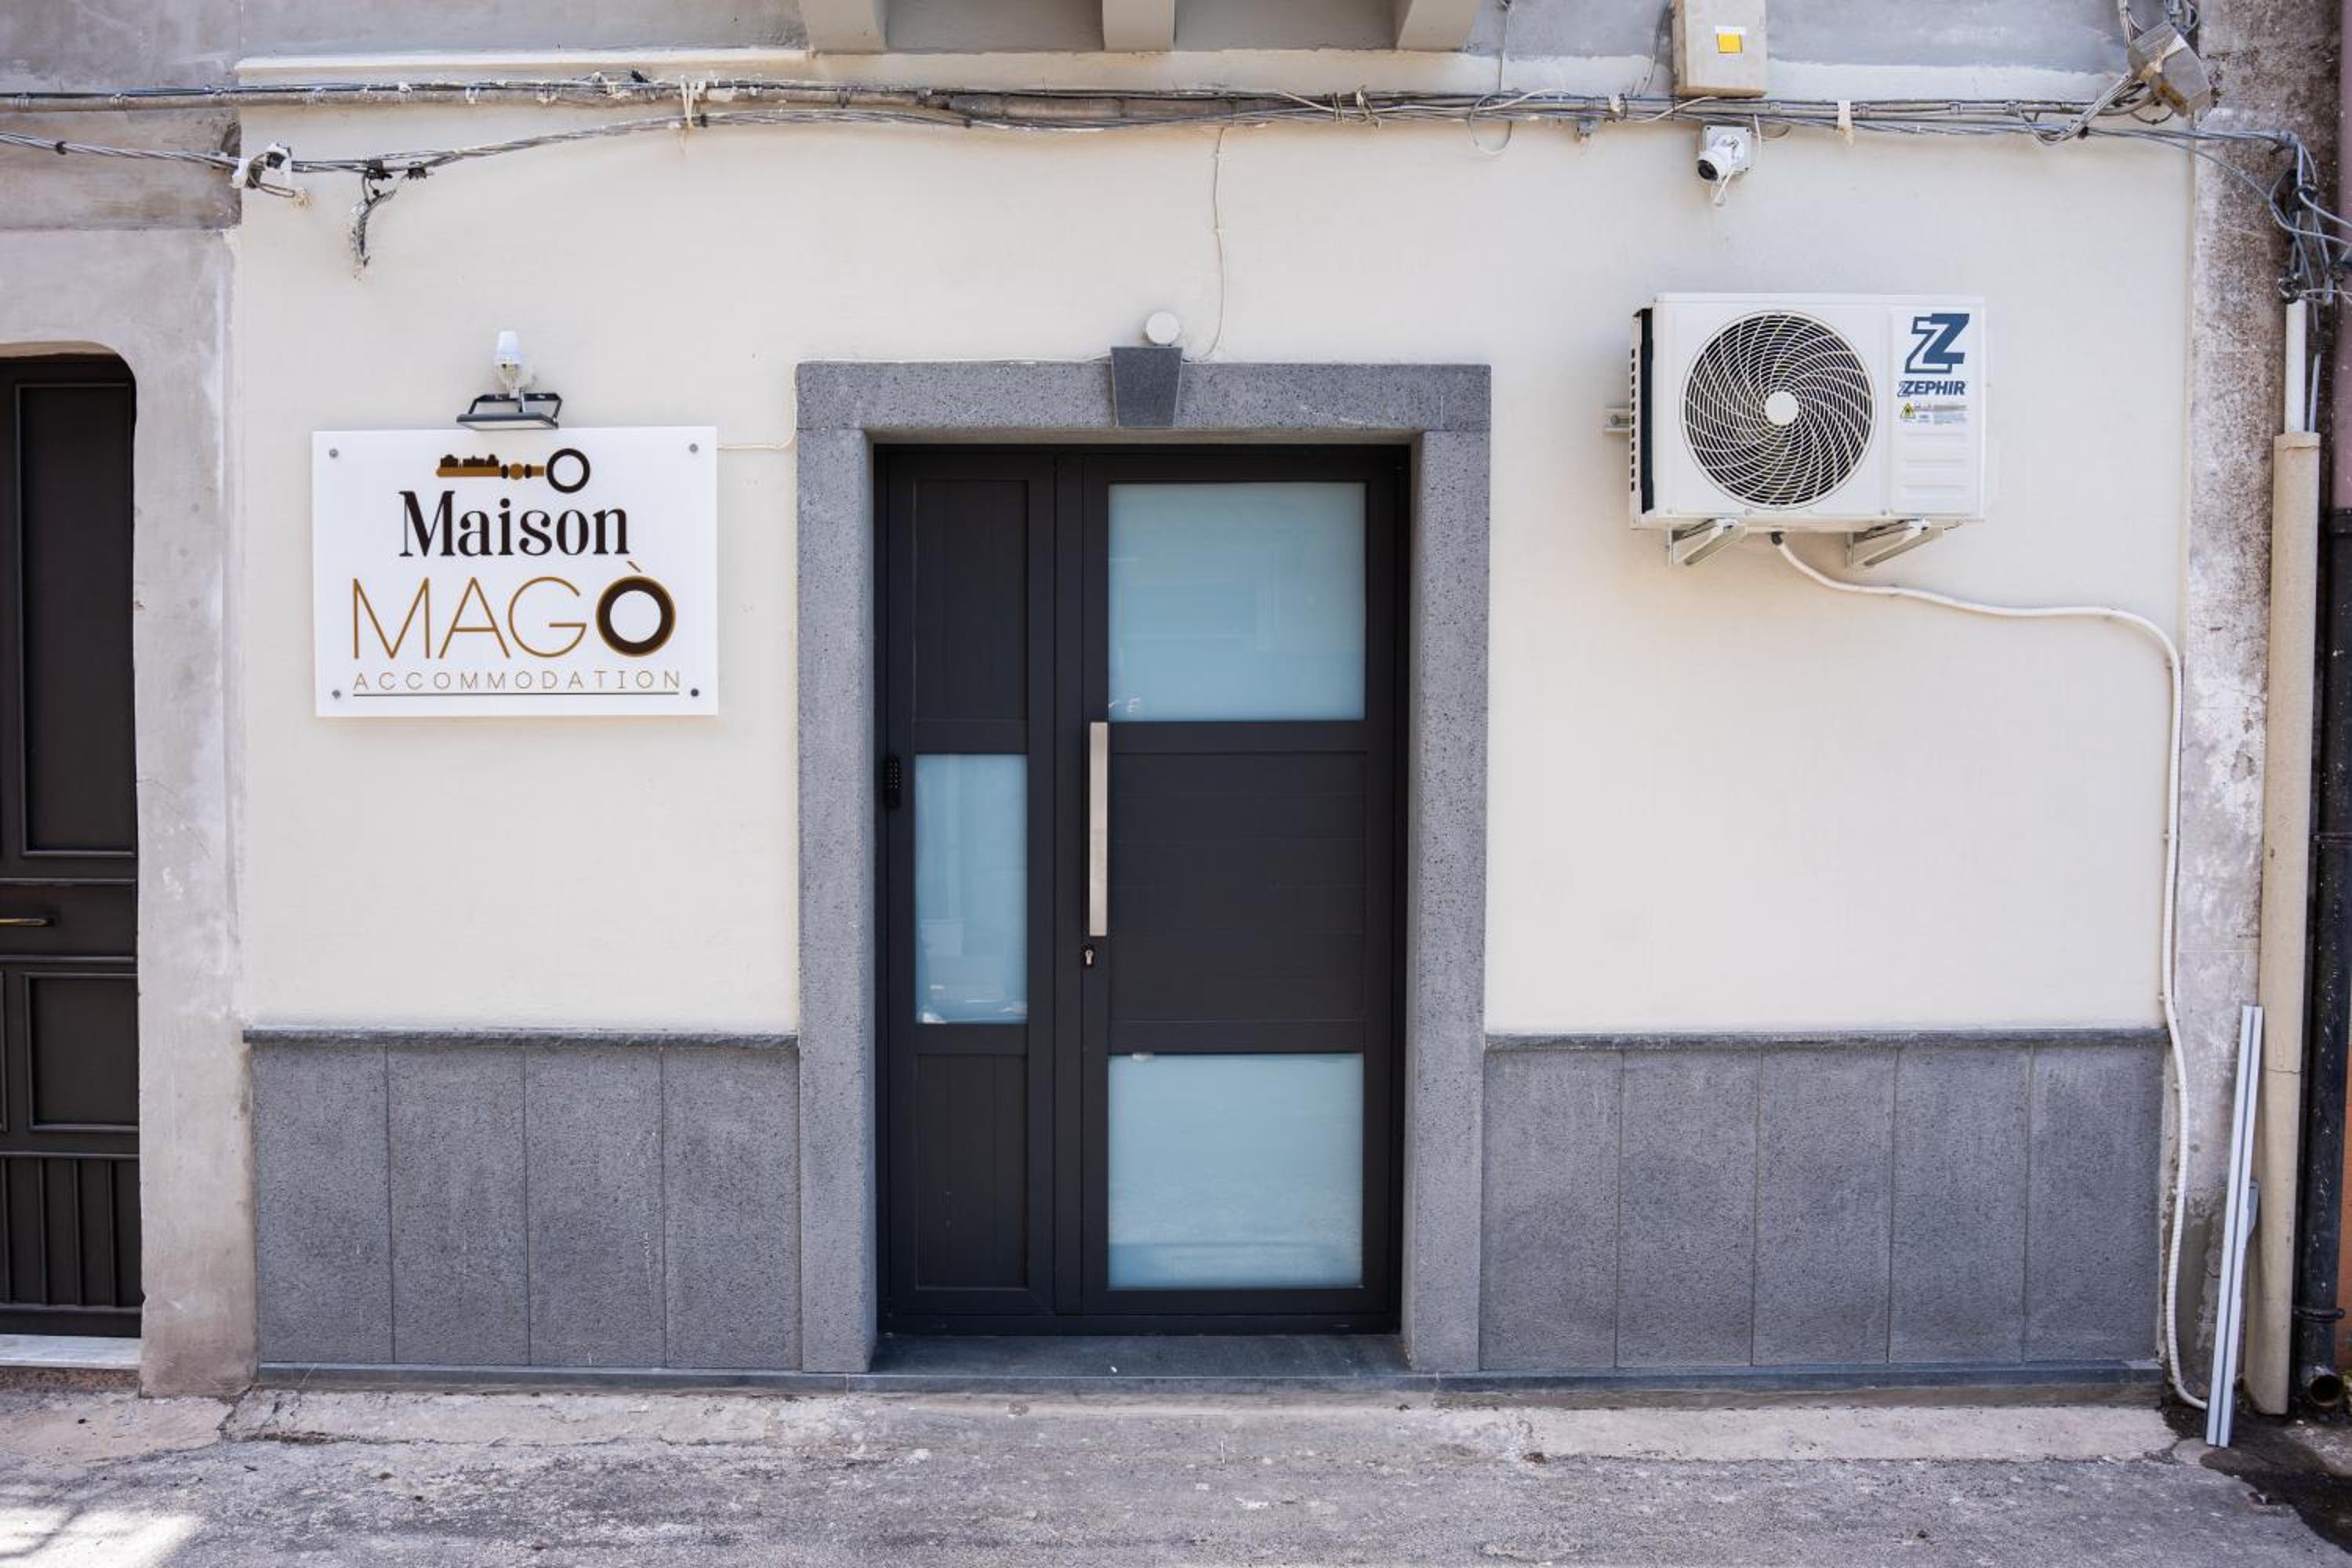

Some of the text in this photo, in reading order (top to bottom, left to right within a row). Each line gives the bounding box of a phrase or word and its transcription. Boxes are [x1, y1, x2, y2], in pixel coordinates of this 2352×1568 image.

[1897, 380, 1966, 397] ZEPHIR
[398, 490, 630, 557] Maison
[353, 561, 677, 659] MAGÒ
[353, 670, 680, 691] ACCOMMODATION
